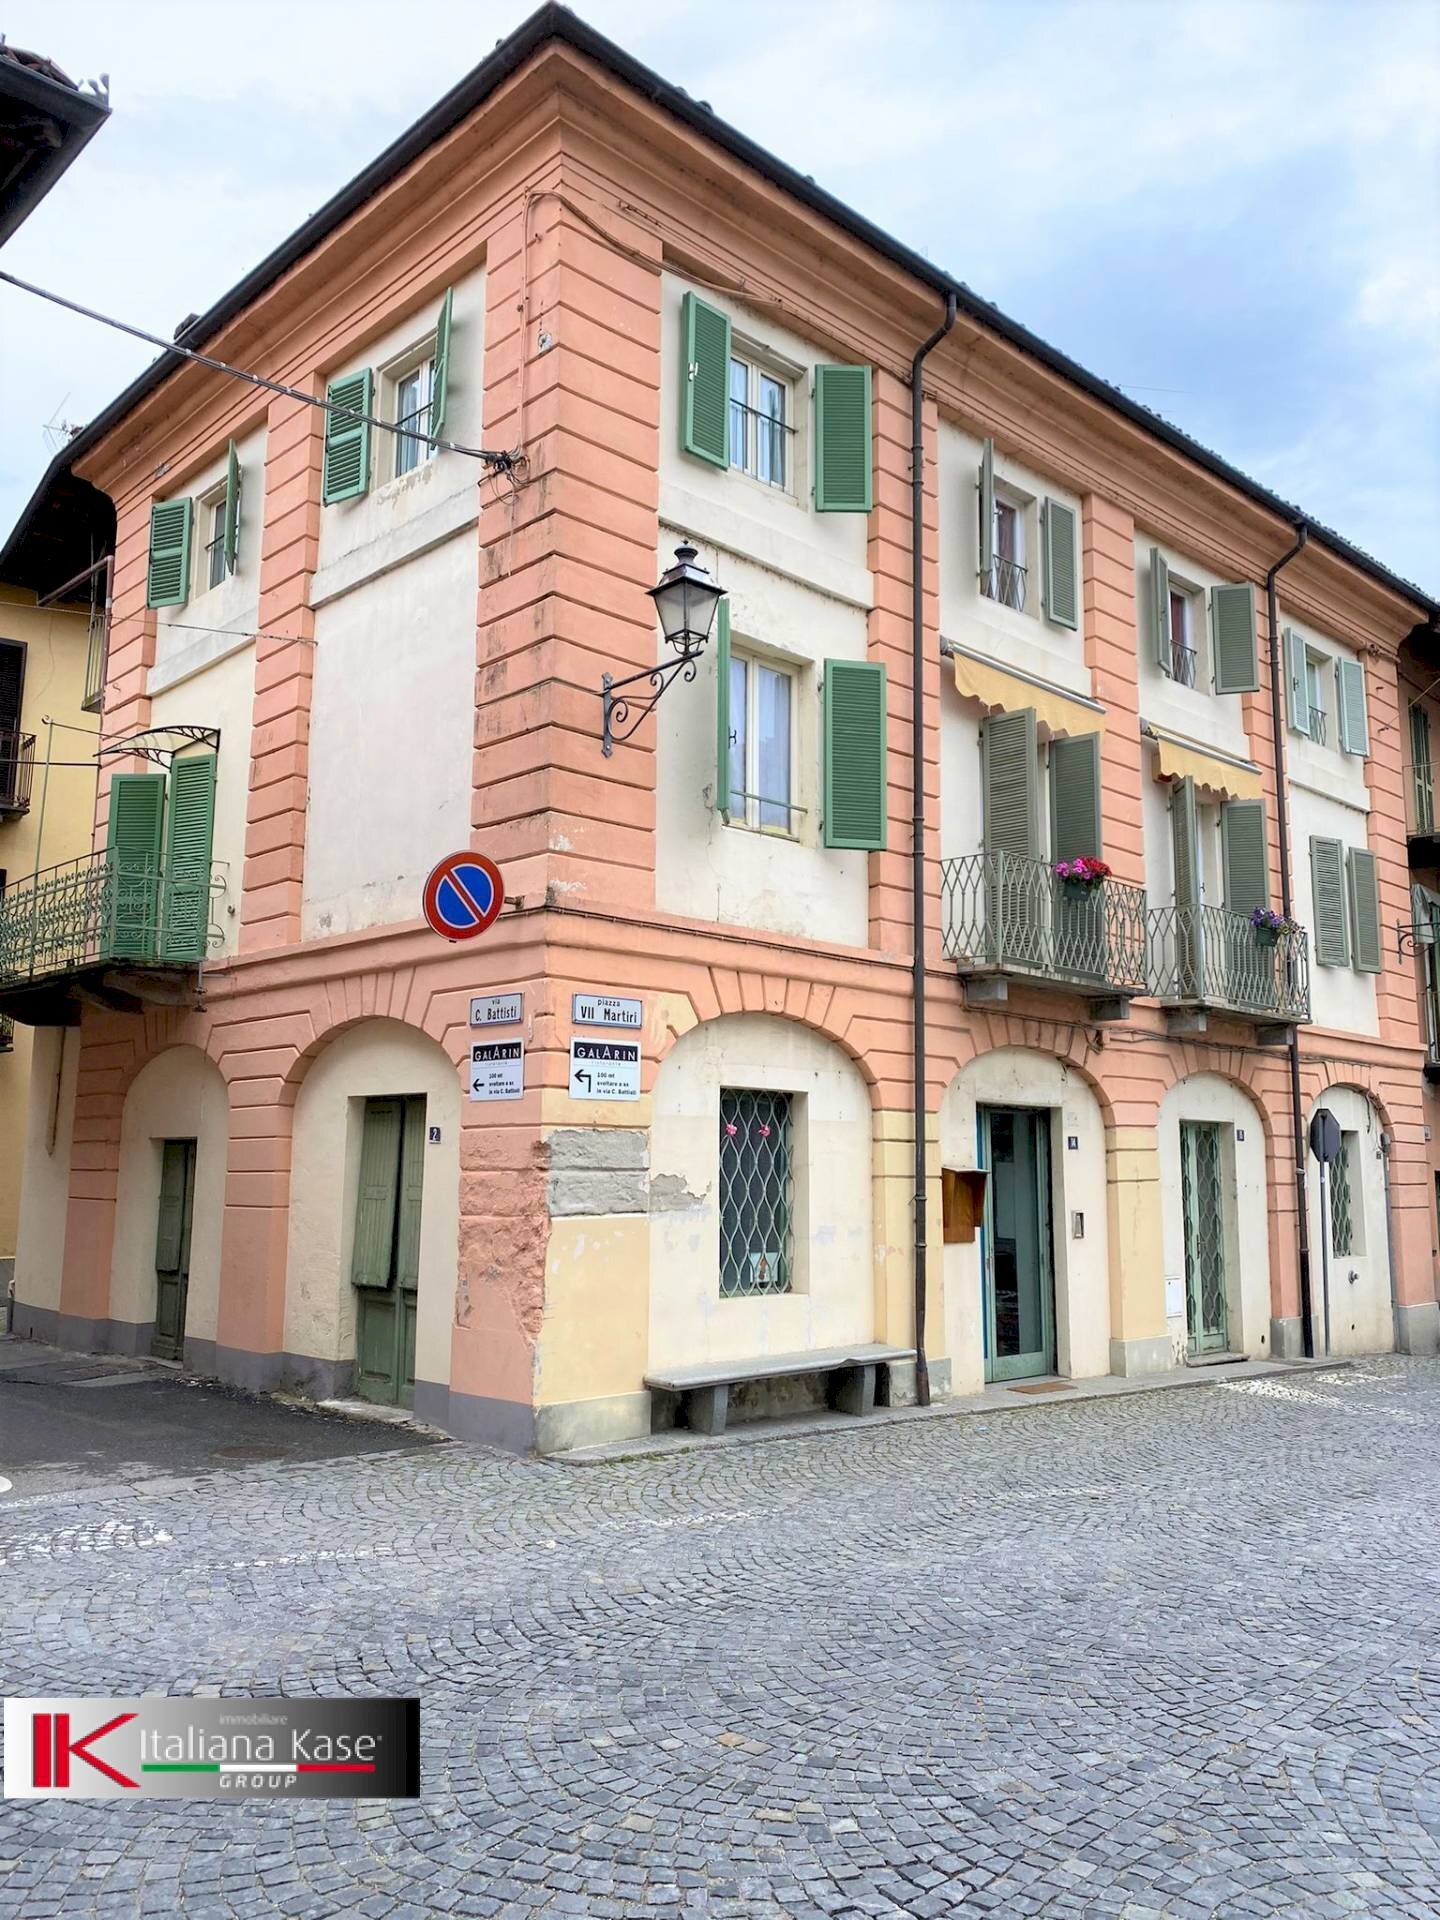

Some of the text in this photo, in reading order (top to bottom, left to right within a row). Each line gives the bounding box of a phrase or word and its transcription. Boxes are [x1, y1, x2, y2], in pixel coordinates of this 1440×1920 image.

[597, 998, 621, 1007] piazza
[475, 1006, 517, 1021] C. Battisti
[580, 1006, 637, 1023] VII Martiri
[474, 1046, 520, 1061] GALARIN
[577, 1045, 636, 1061] GALARIN
